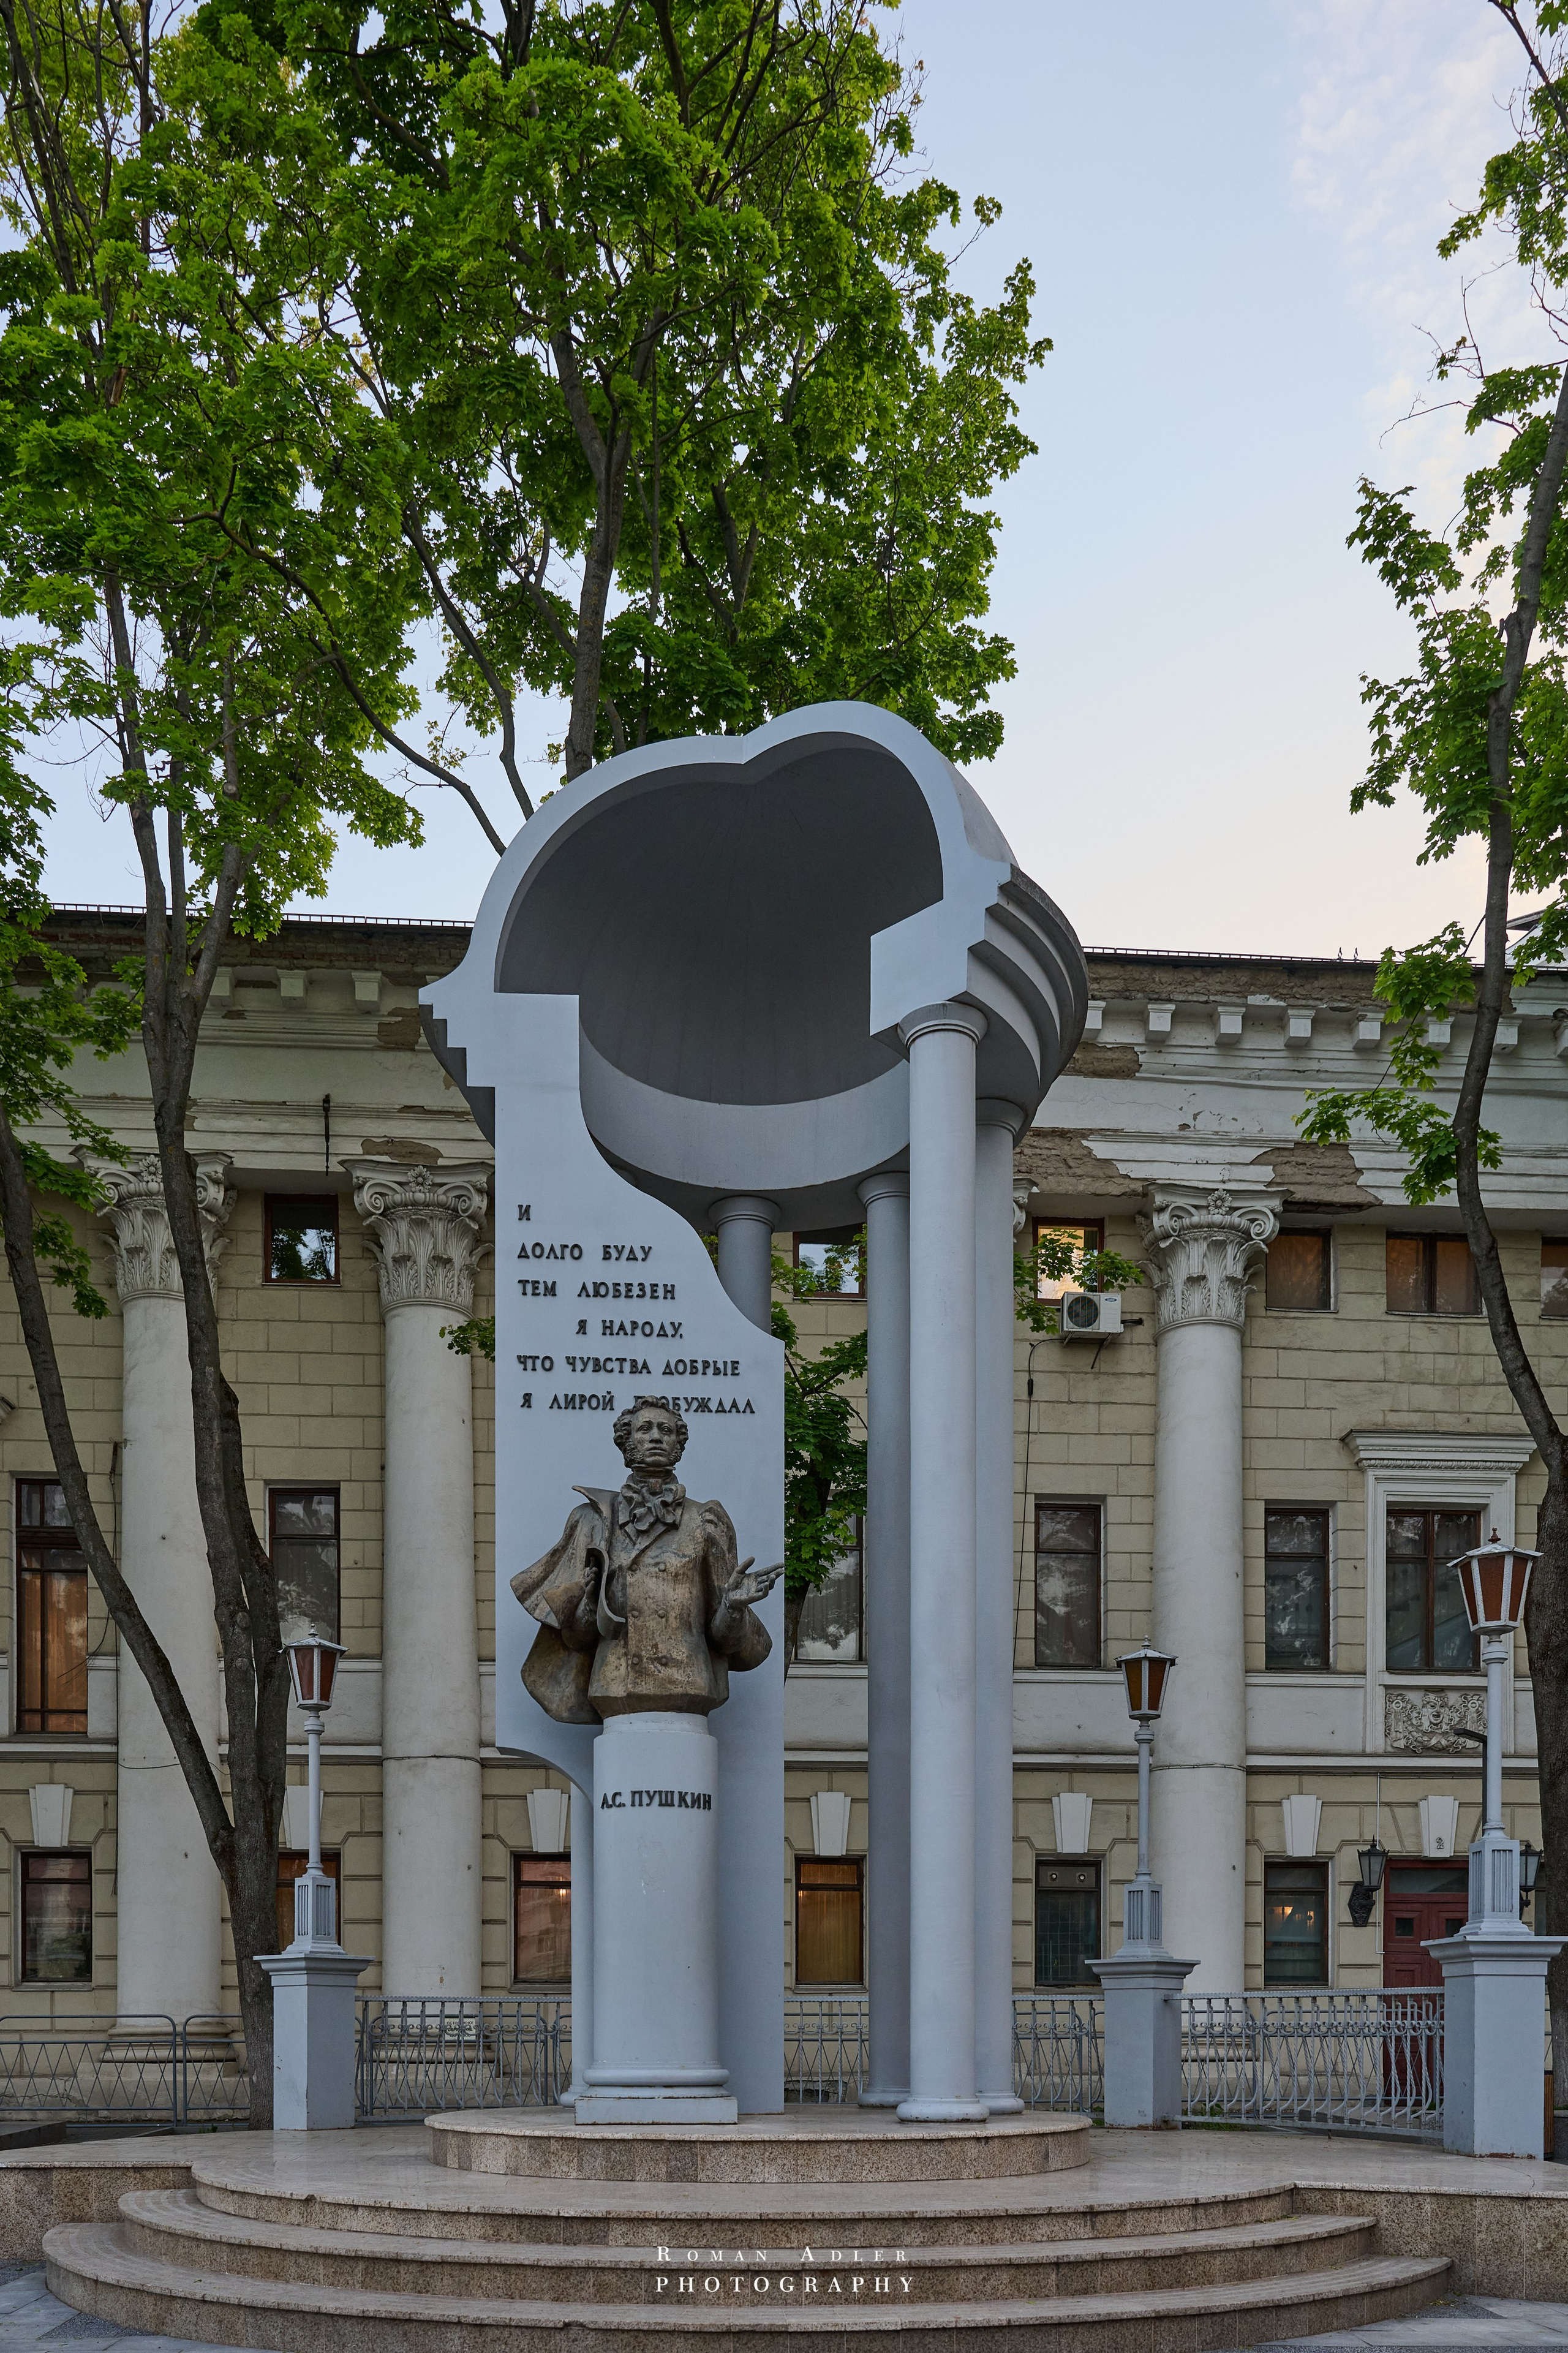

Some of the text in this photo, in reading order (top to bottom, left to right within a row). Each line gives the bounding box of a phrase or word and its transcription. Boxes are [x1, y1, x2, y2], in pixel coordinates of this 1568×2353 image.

[518, 1204, 531, 1221] И
[518, 1242, 652, 1262] ДОЛГО БУДУ
[518, 1279, 676, 1300] ТЕМ ЛЮБЕЗЕН
[576, 1319, 684, 1339] Я НАРОДУ,
[516, 1354, 741, 1377] ЧТО ЧУВСТВА ДОБРЫЕ
[520, 1392, 532, 1409] Я
[549, 1390, 615, 1411] ЛИРОЙ
[630, 1790, 712, 1811] ПУШКИН
[1436, 1837, 1444, 1849] 2
